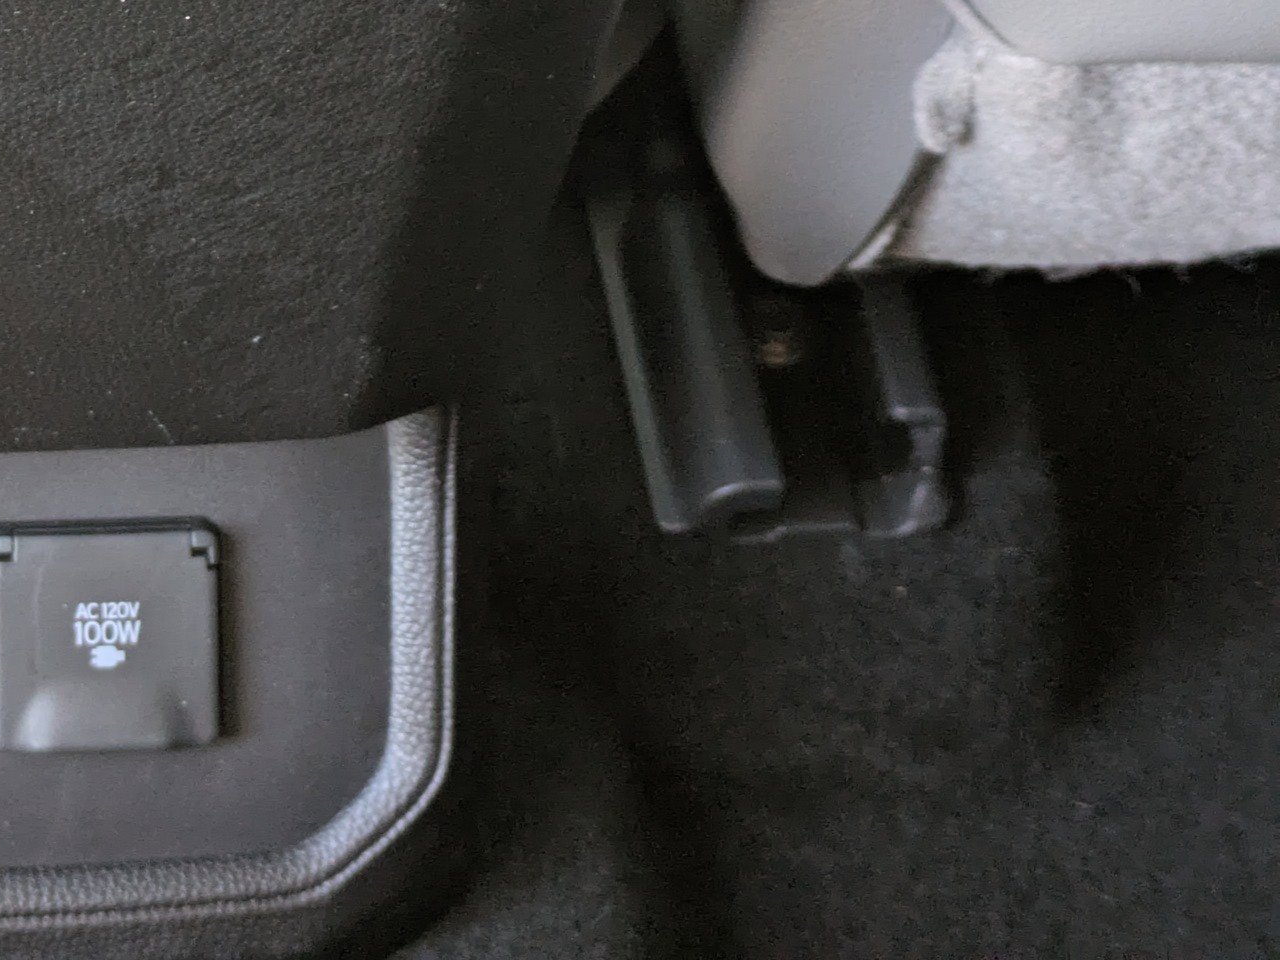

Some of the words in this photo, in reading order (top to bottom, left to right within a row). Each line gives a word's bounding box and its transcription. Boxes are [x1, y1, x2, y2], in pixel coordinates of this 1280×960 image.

[75, 602, 99, 619] AC
[101, 601, 140, 619] 120V
[73, 620, 141, 646] 100W
